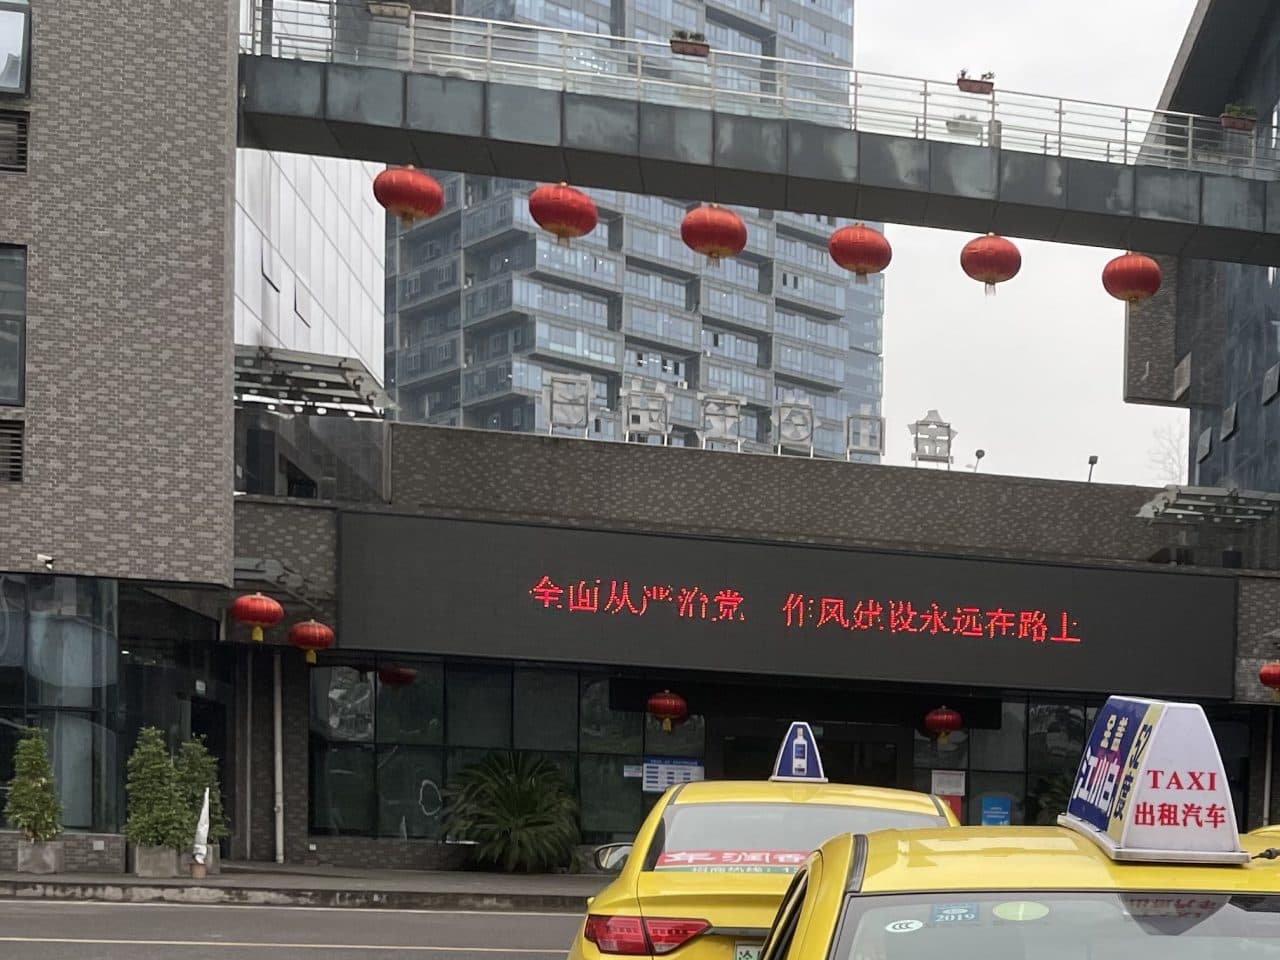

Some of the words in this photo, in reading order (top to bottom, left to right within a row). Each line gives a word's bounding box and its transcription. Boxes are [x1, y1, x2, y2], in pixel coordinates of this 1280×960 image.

[782, 592, 1081, 642] 作风建设永远在路上
[1146, 770, 1218, 791] TAXI
[1134, 801, 1227, 829] 出租汽车
[935, 912, 976, 923] 2019
